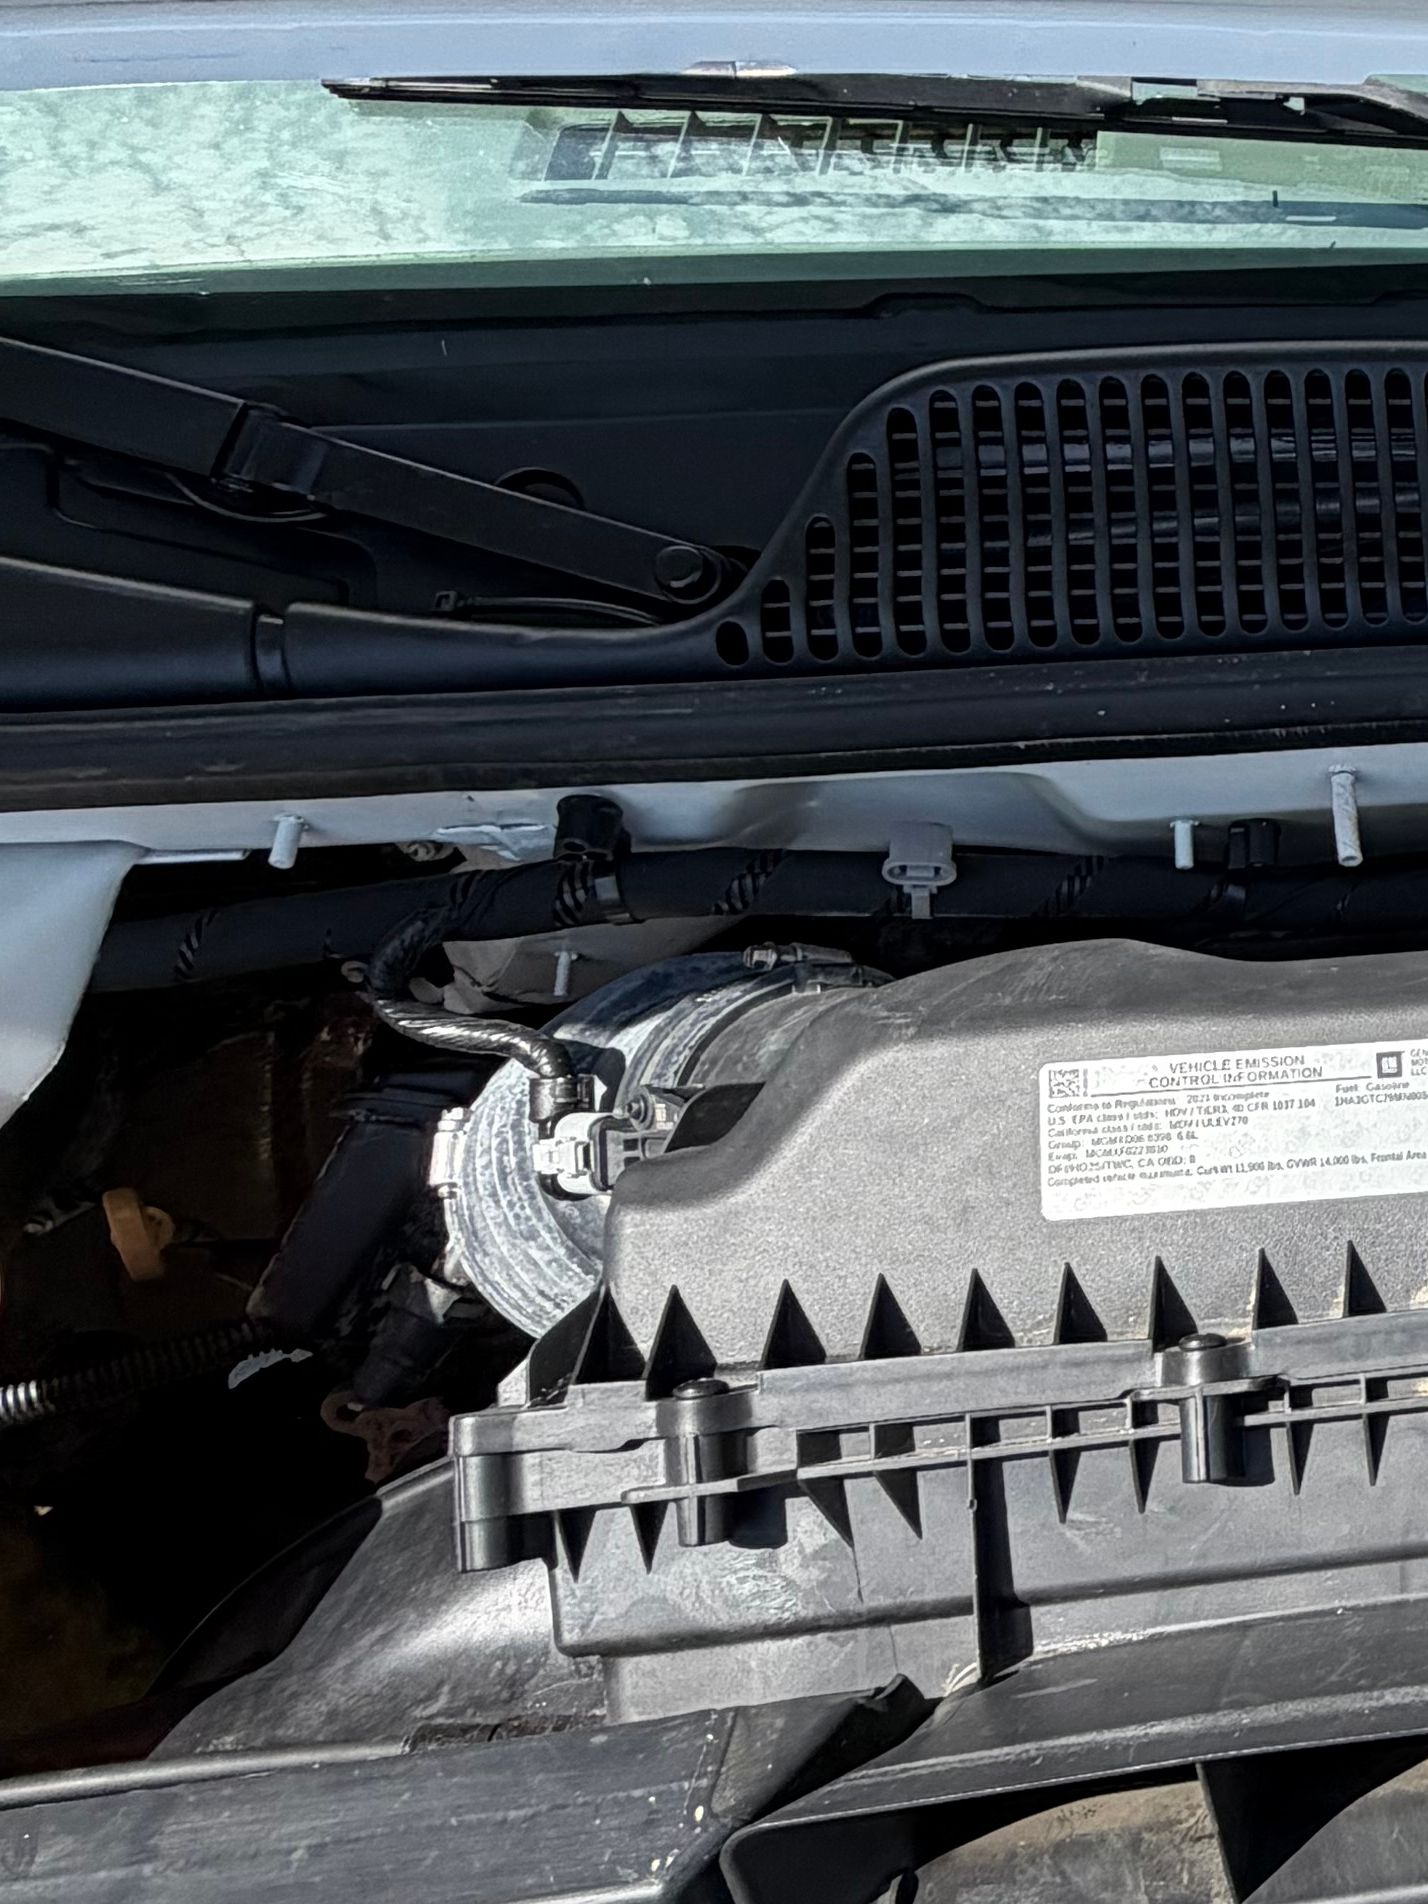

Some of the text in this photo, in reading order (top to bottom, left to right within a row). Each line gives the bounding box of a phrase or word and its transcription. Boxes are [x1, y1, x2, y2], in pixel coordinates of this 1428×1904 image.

[1169, 1056, 1305, 1073] VEHICLE EMISSION
[1410, 1067, 1428, 1075] LLC
[1149, 1068, 1323, 1088] CONTROL INFORMATION
[1365, 1082, 1410, 1091] Gasoline
[1101, 1101, 1113, 1109] to
[1072, 1115, 1093, 1124] EPA
[1247, 1102, 1269, 1111] CFR
[1137, 1158, 1155, 1167] CA
[1286, 1158, 1318, 1168] GVWR
[1405, 1150, 1427, 1160] Area
